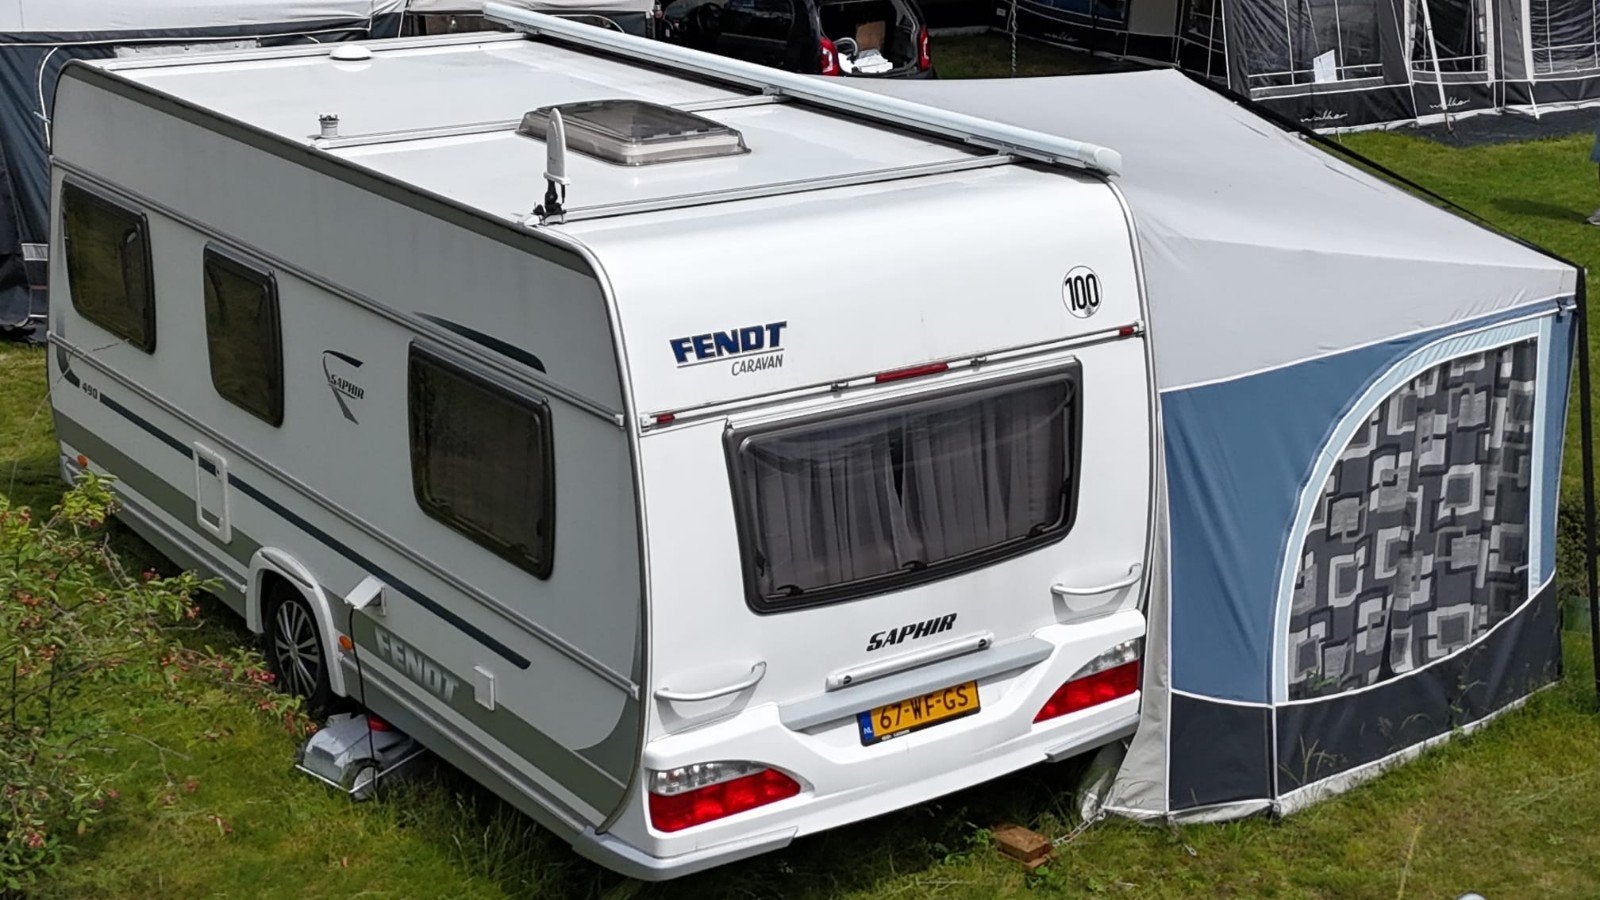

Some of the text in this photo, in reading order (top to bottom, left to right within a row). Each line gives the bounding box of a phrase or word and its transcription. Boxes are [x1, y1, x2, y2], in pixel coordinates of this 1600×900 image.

[1429, 96, 1471, 109] wlker
[1065, 273, 1099, 311] 100
[669, 320, 787, 364] FENDT
[731, 354, 783, 376] CARAVAN
[82, 382, 98, 400] 490
[330, 374, 365, 400] SAPHIR
[866, 612, 957, 652] SAPHIR
[375, 627, 459, 702] FENDT
[879, 685, 969, 730] 67-WF-GS
[863, 726, 873, 735] NL
